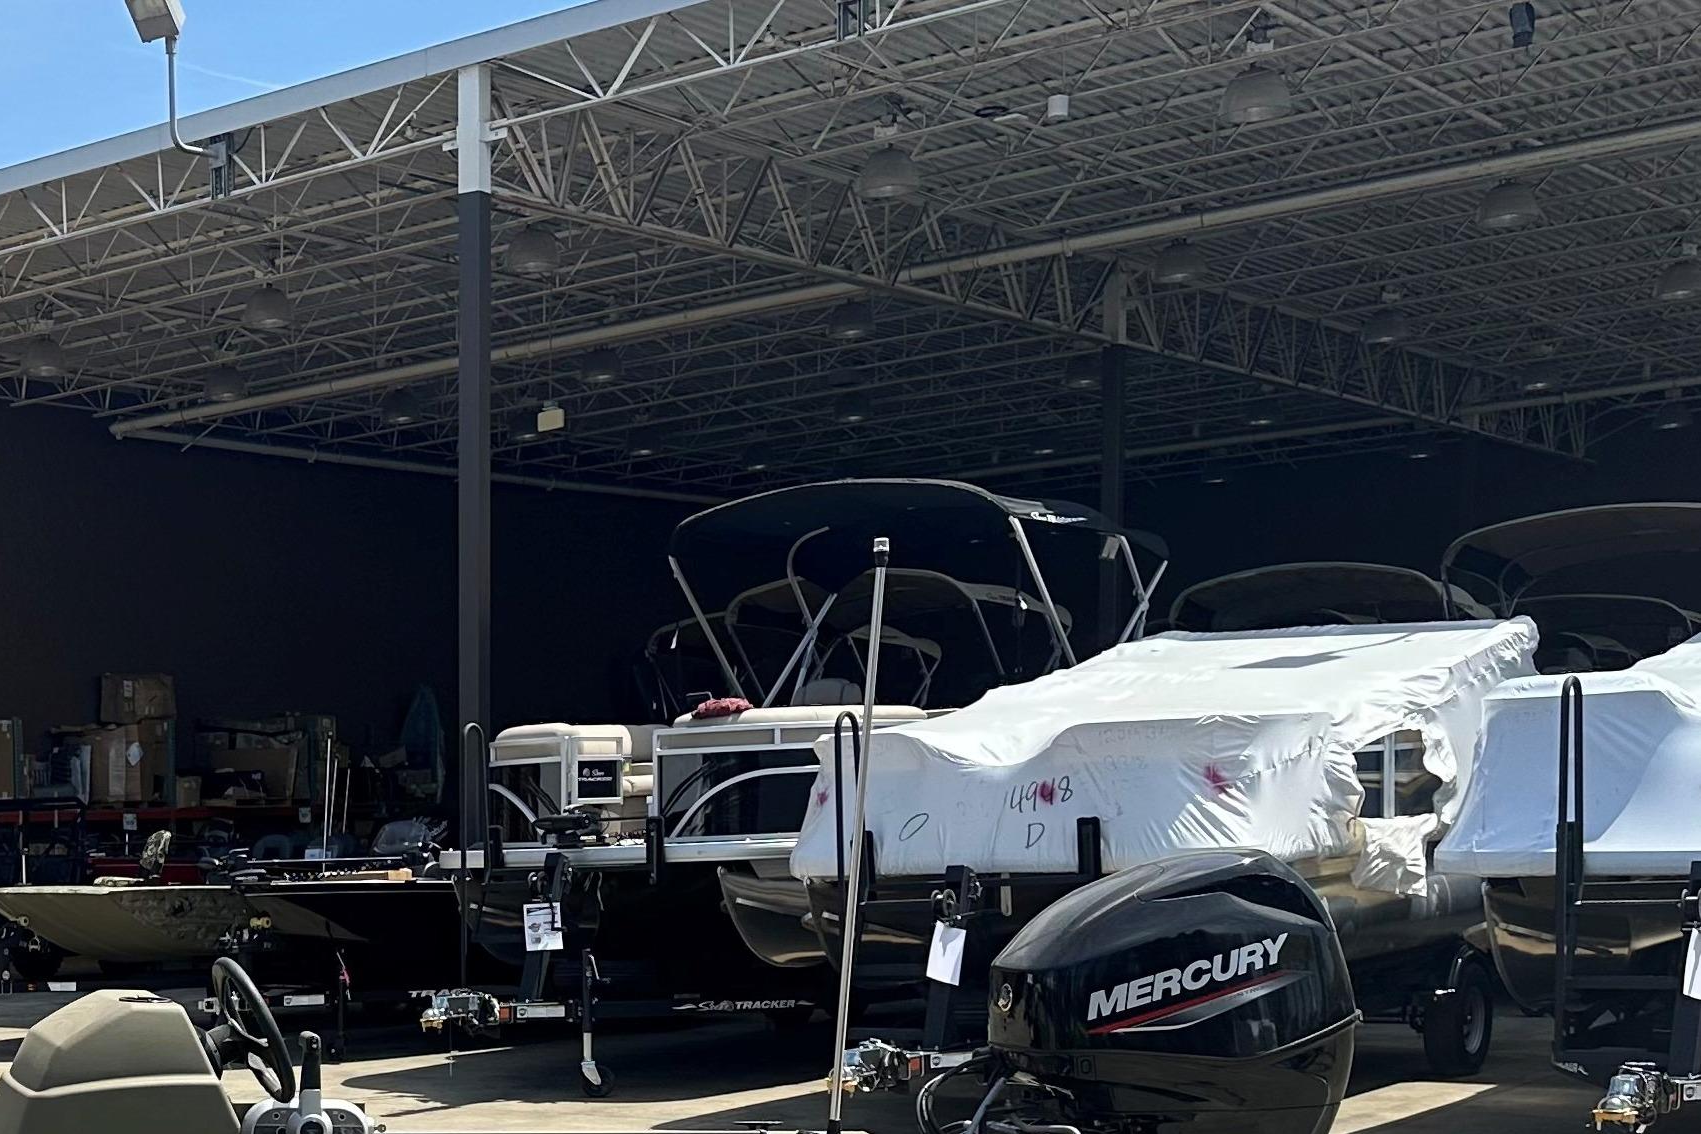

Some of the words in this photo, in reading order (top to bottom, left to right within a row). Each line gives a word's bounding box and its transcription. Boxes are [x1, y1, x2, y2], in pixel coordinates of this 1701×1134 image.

[1024, 822, 1046, 849] D
[1086, 932, 1289, 1021] MERCURY
[735, 1000, 796, 1010] TRACKER
